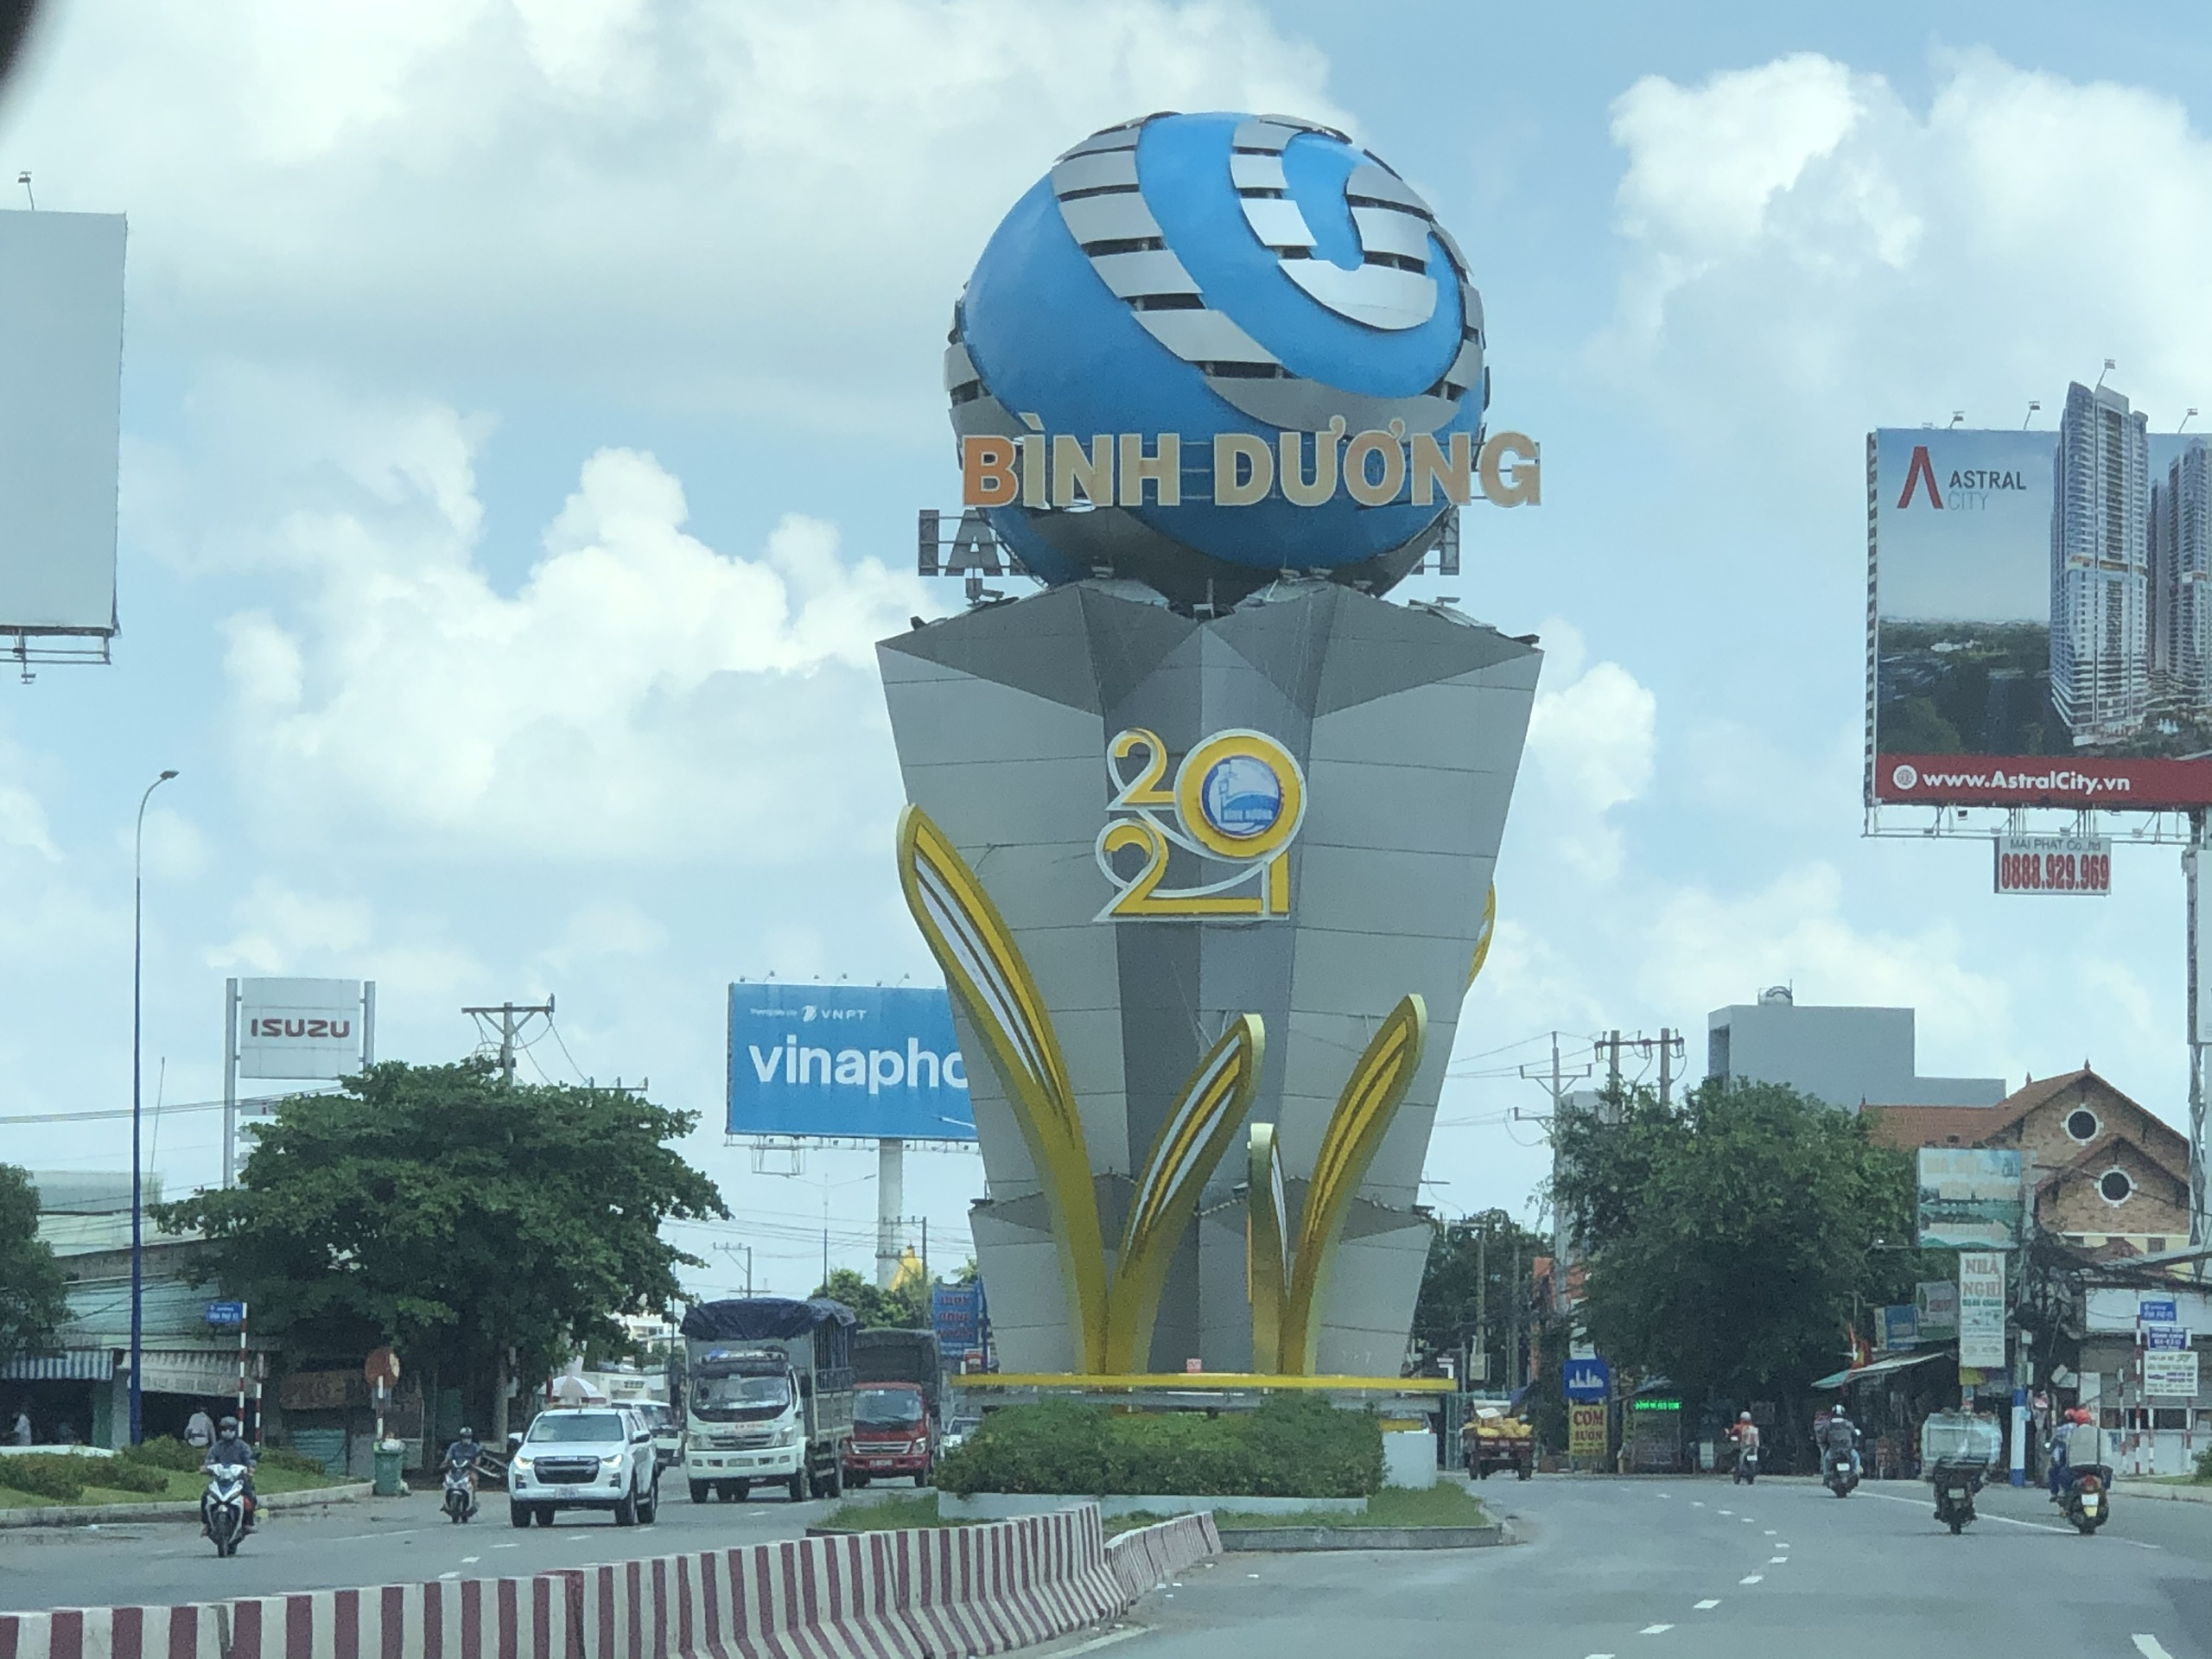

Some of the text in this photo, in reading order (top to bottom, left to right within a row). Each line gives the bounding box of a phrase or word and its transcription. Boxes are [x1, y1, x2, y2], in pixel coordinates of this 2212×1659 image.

[962, 412, 1541, 508] BÌNH DƯƠNG
[1948, 469, 2027, 491] ASTRAL
[1947, 490, 1989, 511] CITY
[1923, 770, 2131, 795] www.AstralCity.vn
[2010, 839, 2031, 849] MAI
[2001, 853, 2110, 890] 0888.929.969
[821, 1008, 868, 1020] VNPT
[251, 1018, 351, 1039] ISUZU
